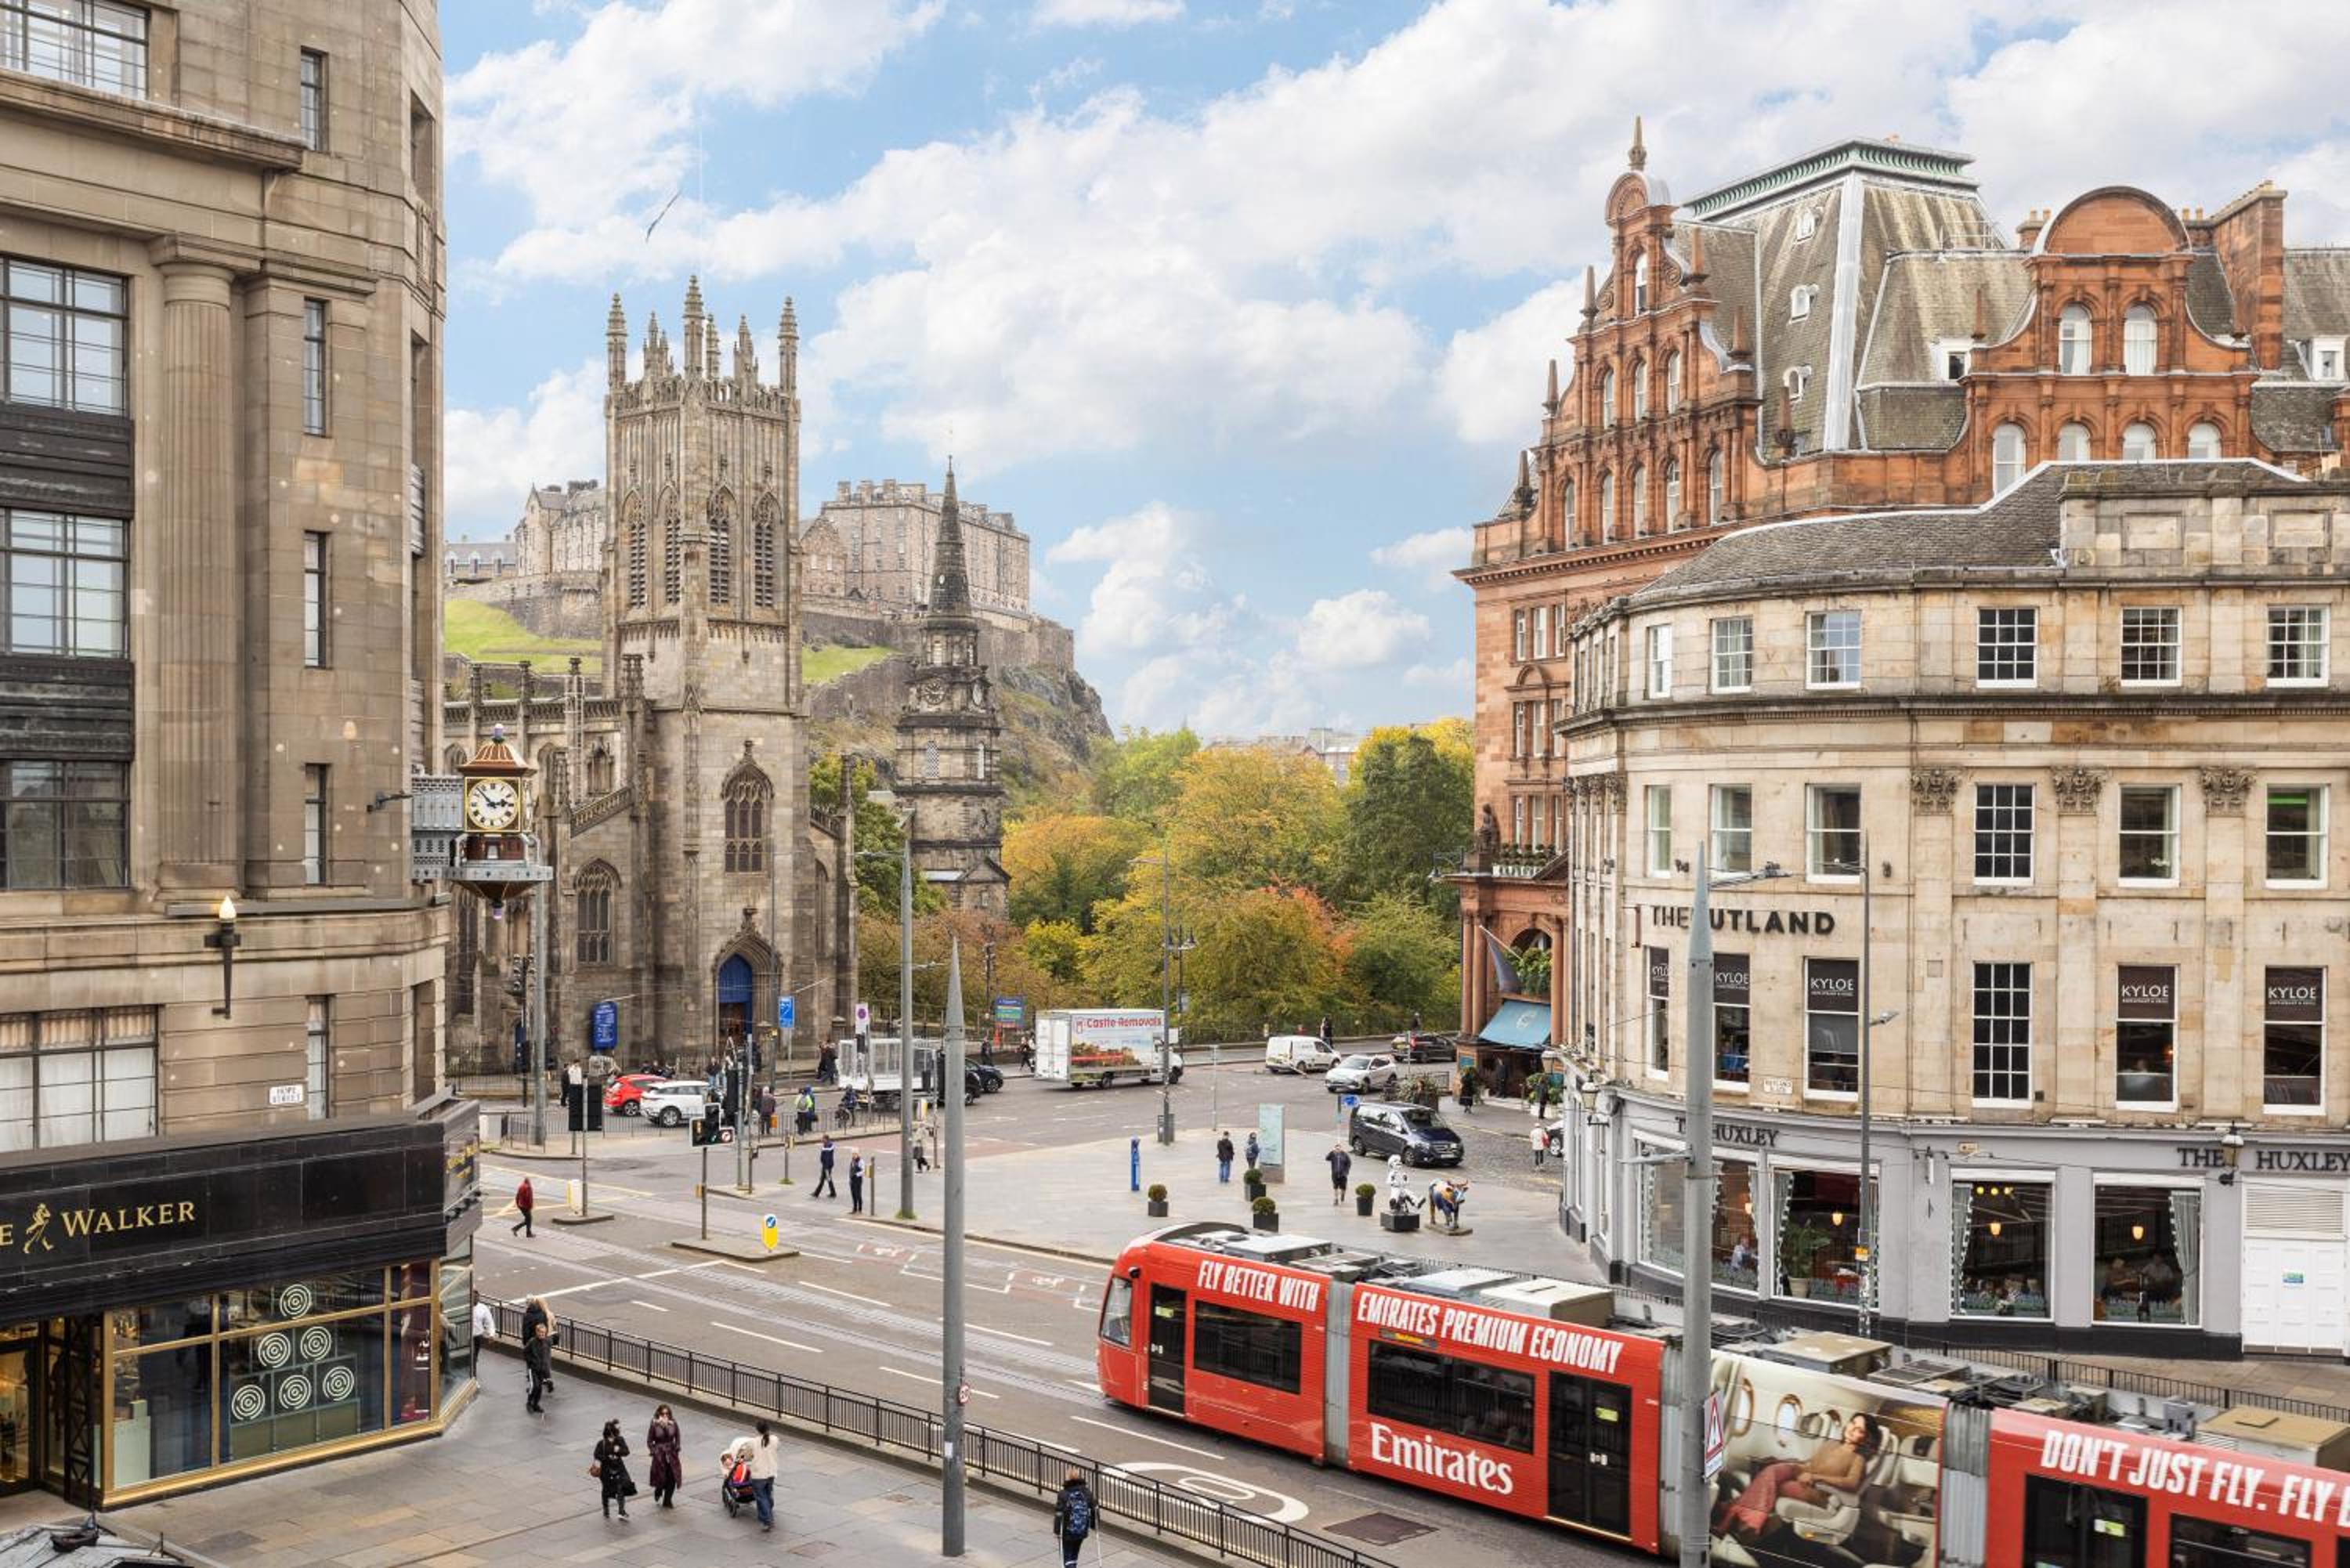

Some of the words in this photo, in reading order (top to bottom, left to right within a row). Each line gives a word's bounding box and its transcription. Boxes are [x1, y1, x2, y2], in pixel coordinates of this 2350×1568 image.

[1652, 905, 1689, 929] THE
[1692, 907, 1835, 935] UTLAND
[1716, 972, 1749, 985] KYLOE
[1810, 977, 1854, 991] KYLOE
[2121, 985, 2169, 997] KYLOE
[2268, 986, 2316, 999] KYLOE
[1086, 1017, 1116, 1028] Castle
[1118, 1016, 1162, 1027] Removals
[2178, 1147, 2225, 1167] THE
[2255, 1151, 2350, 1172] HUXLEY
[61, 1201, 196, 1237] WALKER
[1197, 1259, 1224, 1290] FLY
[1222, 1265, 1278, 1302] BETTER
[1278, 1276, 1320, 1312] WITH
[1357, 1291, 1440, 1336] EMIRATES
[1441, 1306, 1528, 1354] PREMIUM
[1529, 1325, 1624, 1374] ECONOMY
[1370, 1422, 1513, 1495] Emirates
[2041, 1429, 2130, 1481] DON'T
[2127, 1446, 2208, 1498] JUST
[2209, 1460, 2267, 1512] FLY.
[2278, 1473, 2336, 1522] FLY
